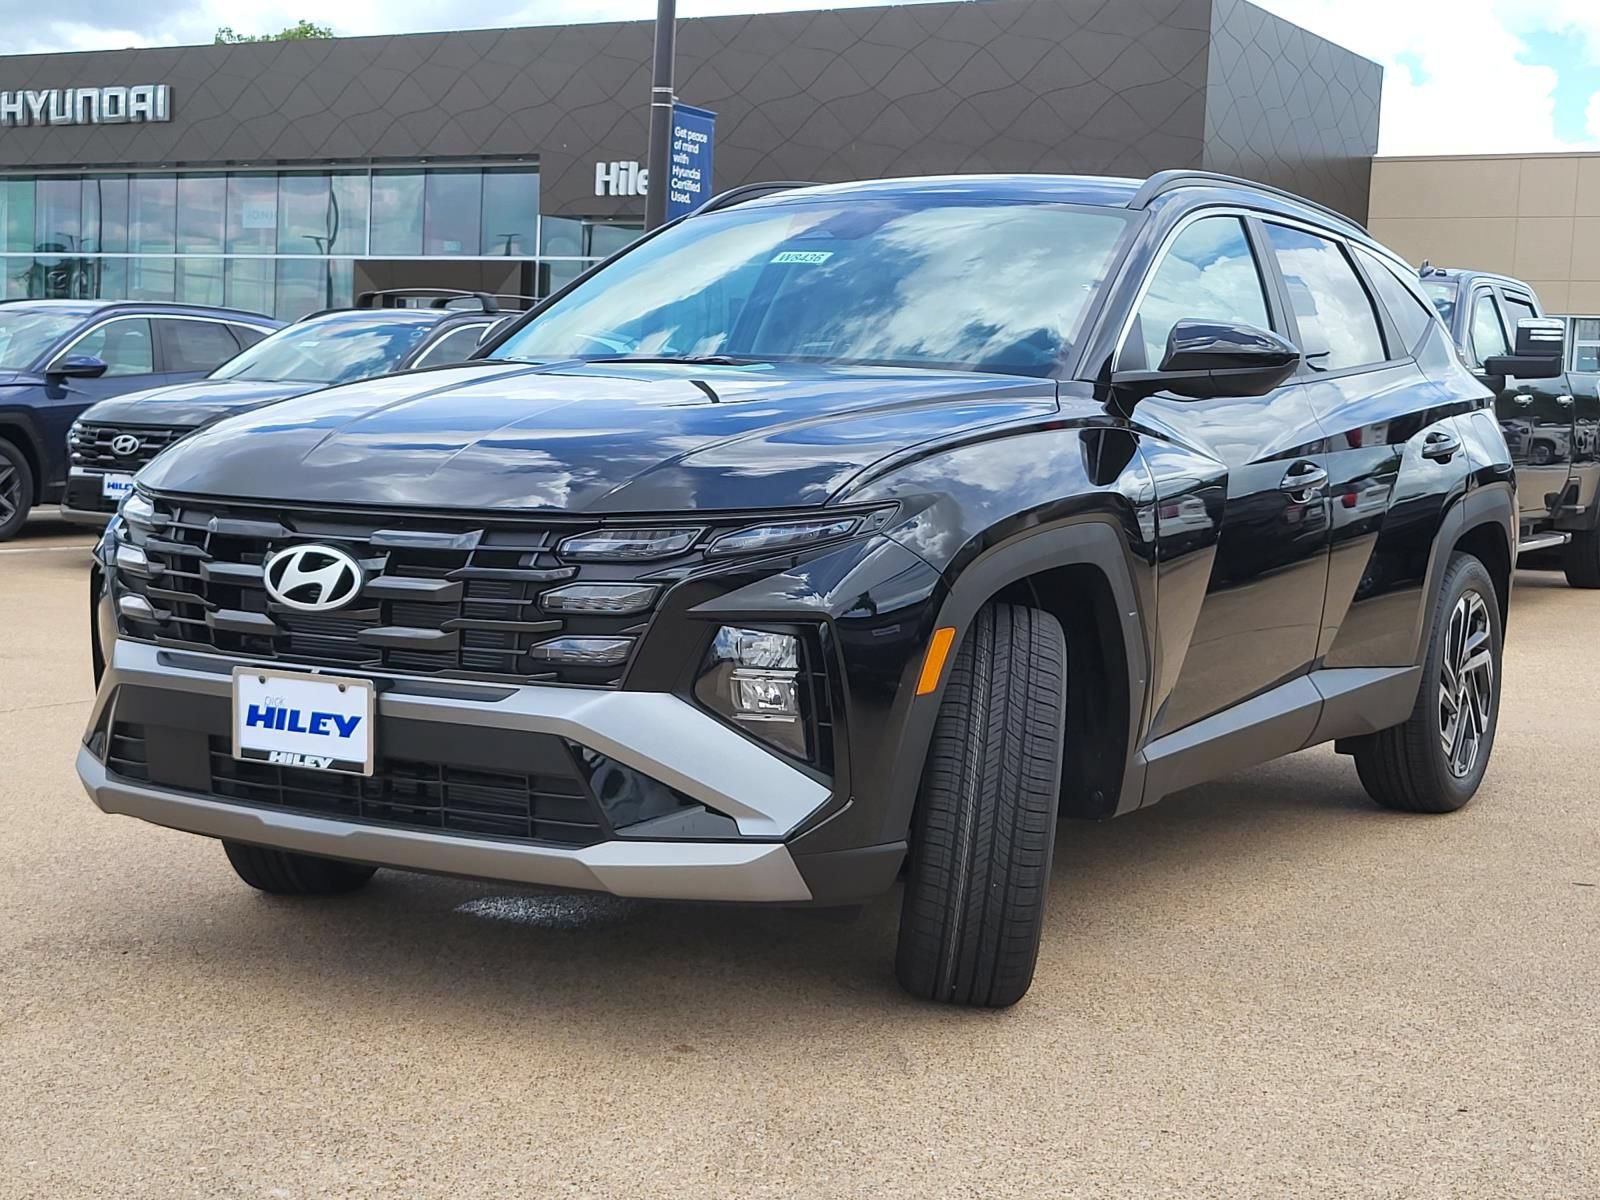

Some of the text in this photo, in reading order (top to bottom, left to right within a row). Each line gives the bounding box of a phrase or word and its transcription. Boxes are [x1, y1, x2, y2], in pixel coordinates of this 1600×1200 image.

[0, 84, 170, 126] HYUNDAI
[674, 126, 708, 143] Get peace
[673, 140, 699, 154] of mind
[673, 153, 689, 165] with
[595, 161, 648, 196] Hile
[672, 165, 701, 179] Hyundai
[671, 178, 701, 193] Certified
[107, 482, 133, 490] HILE
[246, 704, 362, 738] HILEY
[269, 751, 333, 768] HILEY
